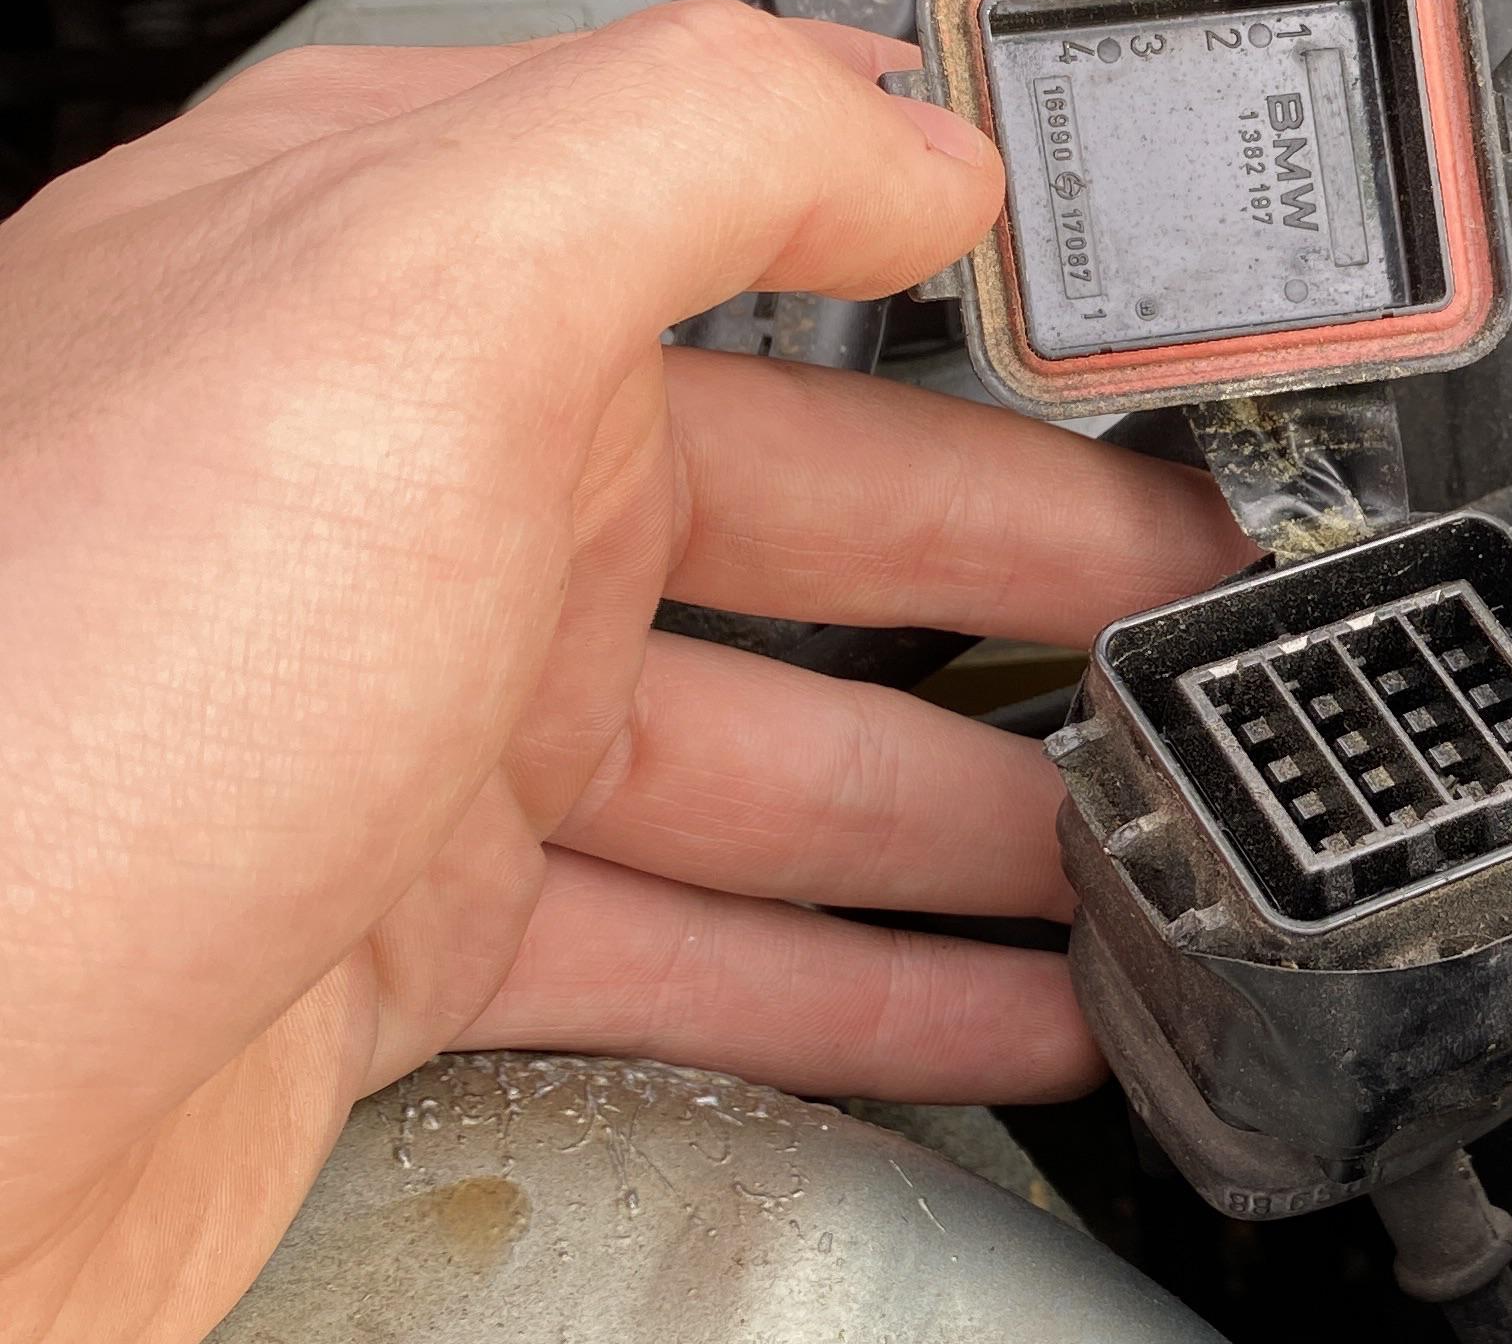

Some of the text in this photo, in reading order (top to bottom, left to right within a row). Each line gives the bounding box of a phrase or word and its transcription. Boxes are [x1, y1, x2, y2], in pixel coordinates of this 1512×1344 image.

[1205, 28, 1242, 52] 2
[1277, 23, 1312, 40] 1
[1058, 40, 1095, 65] 4
[1130, 33, 1168, 57] 3
[1240, 129, 1267, 176] 382
[1266, 92, 1320, 233] BMW
[1042, 85, 1093, 284] 16990 17087
